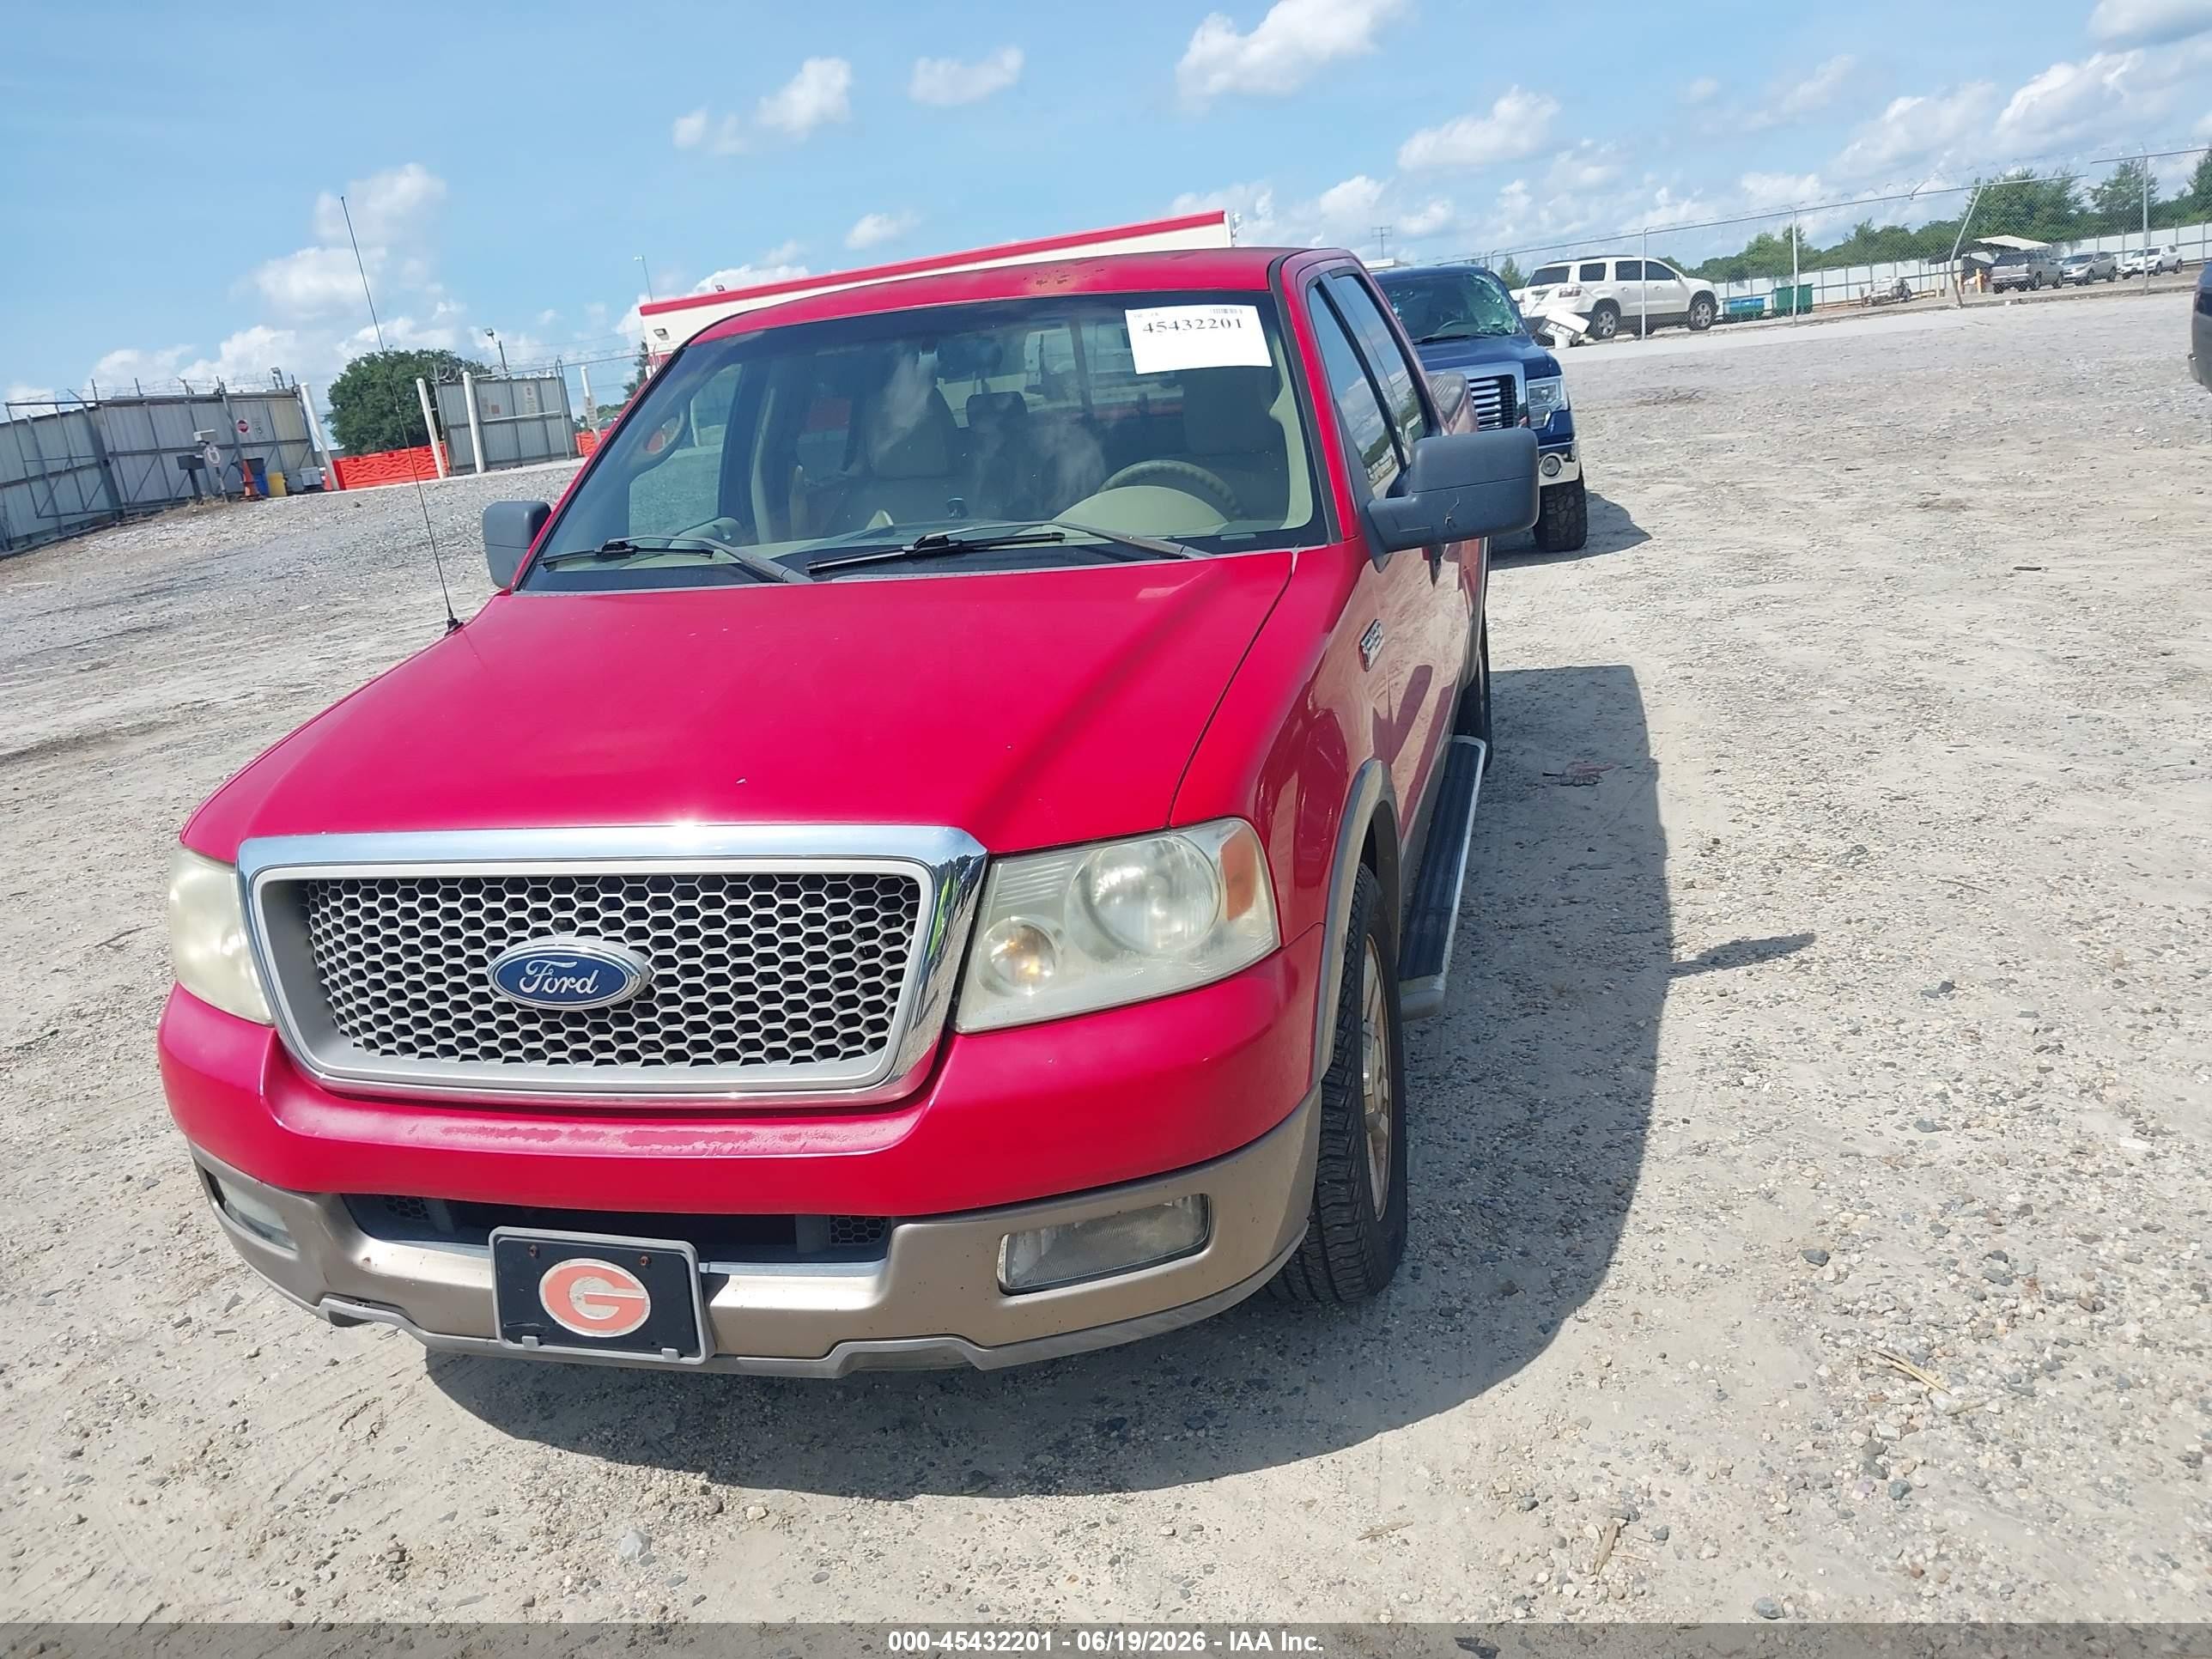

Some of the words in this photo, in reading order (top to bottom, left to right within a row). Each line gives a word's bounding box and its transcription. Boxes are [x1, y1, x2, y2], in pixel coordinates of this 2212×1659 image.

[1143, 318, 1243, 334] 45432201
[519, 959, 599, 994] Ford
[542, 1262, 649, 1334] G
